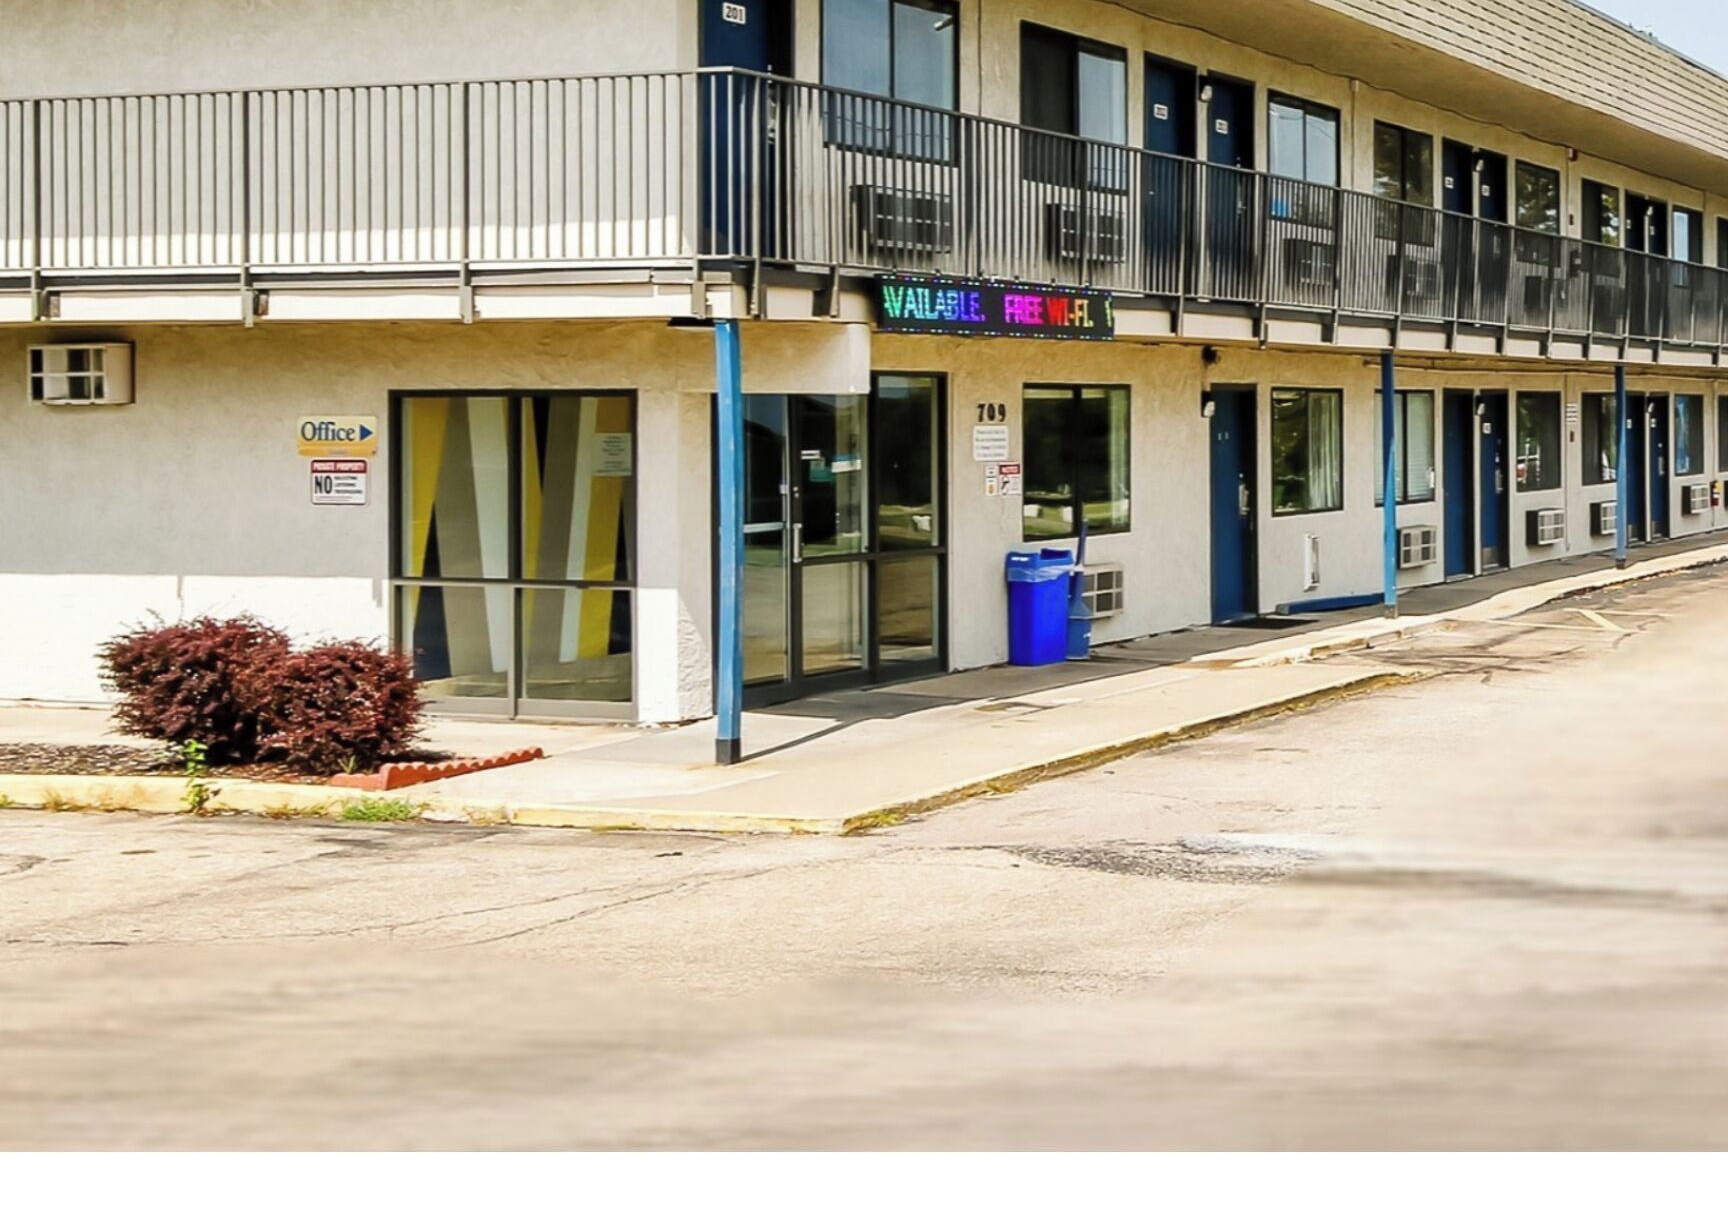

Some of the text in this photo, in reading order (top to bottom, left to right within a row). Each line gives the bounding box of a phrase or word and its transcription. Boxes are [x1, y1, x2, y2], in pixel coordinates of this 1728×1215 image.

[1004, 294, 1044, 324] FREE
[977, 403, 1007, 423] 709
[300, 421, 356, 442] Office
[314, 475, 333, 495] NO
